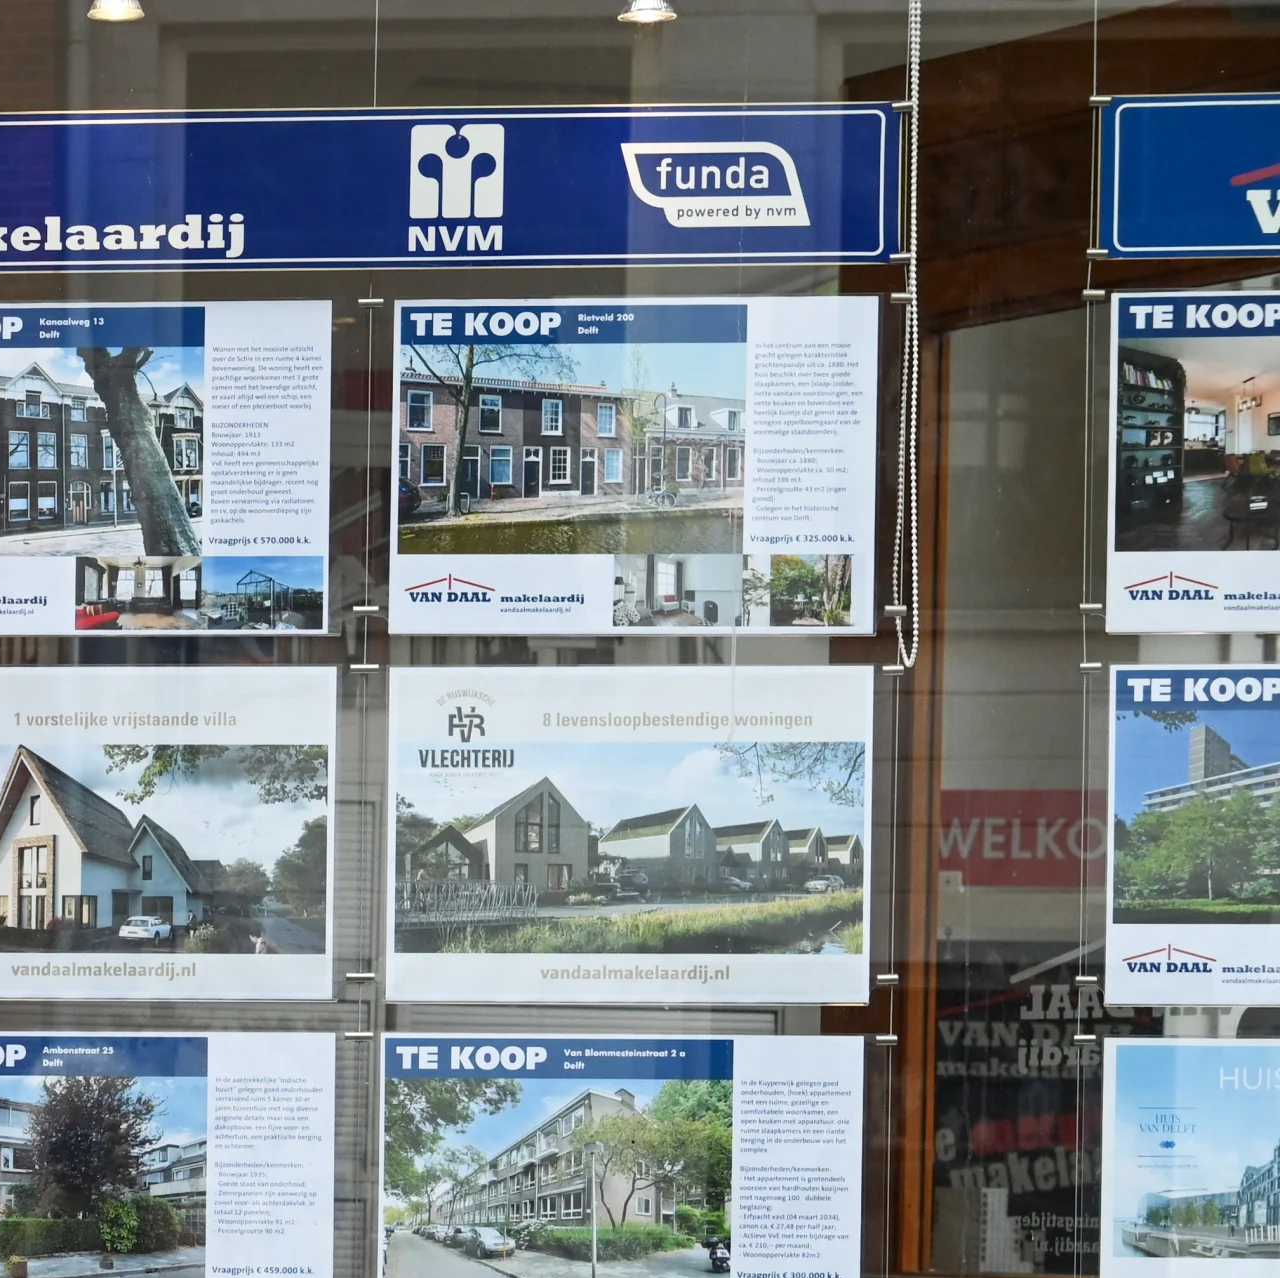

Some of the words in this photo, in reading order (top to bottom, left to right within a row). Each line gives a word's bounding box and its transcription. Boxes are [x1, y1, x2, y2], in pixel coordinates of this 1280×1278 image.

[656, 158, 770, 190] funda
[677, 205, 740, 220] powered
[745, 204, 761, 220] by
[767, 206, 797, 217] nvm
[408, 225, 503, 251] NVM
[39, 317, 89, 327] Kanaalweg
[93, 317, 104, 326] 13
[578, 313, 613, 322] Rietveld
[617, 313, 634, 322] 200
[1129, 306, 1172, 329] TE
[39, 330, 60, 339] Delft
[578, 326, 599, 335] Delft
[750, 534, 793, 544] Vraagprijs
[796, 535, 801, 543] €
[803, 534, 837, 543] 325.000
[840, 534, 855, 543] k.k.
[14, 712, 21, 726] 1
[26, 712, 108, 729] vorstelijke
[113, 712, 200, 729] vrijstaande
[204, 712, 237, 726] villa
[543, 713, 551, 727] 8
[556, 712, 729, 731] levensloopbestendige
[735, 712, 813, 730] woningen
[418, 749, 515, 769] VLECHTERIJ
[11, 962, 196, 980] vandaalmakelaardij.nl
[540, 966, 730, 984] vandaalmakelaardij.nl
[43, 1046, 99, 1055] Ambonstraat
[102, 1047, 113, 1055] 25
[564, 1049, 581, 1058] Van
[584, 1049, 668, 1058] Blommesteinstraat
[671, 1050, 677, 1058] 2
[43, 1059, 63, 1067] Delft
[564, 1061, 585, 1070] Delft
[1156, 1114, 1180, 1123] HUIS
[1139, 1124, 1160, 1132] VAN
[1163, 1124, 1197, 1134] DELFT
